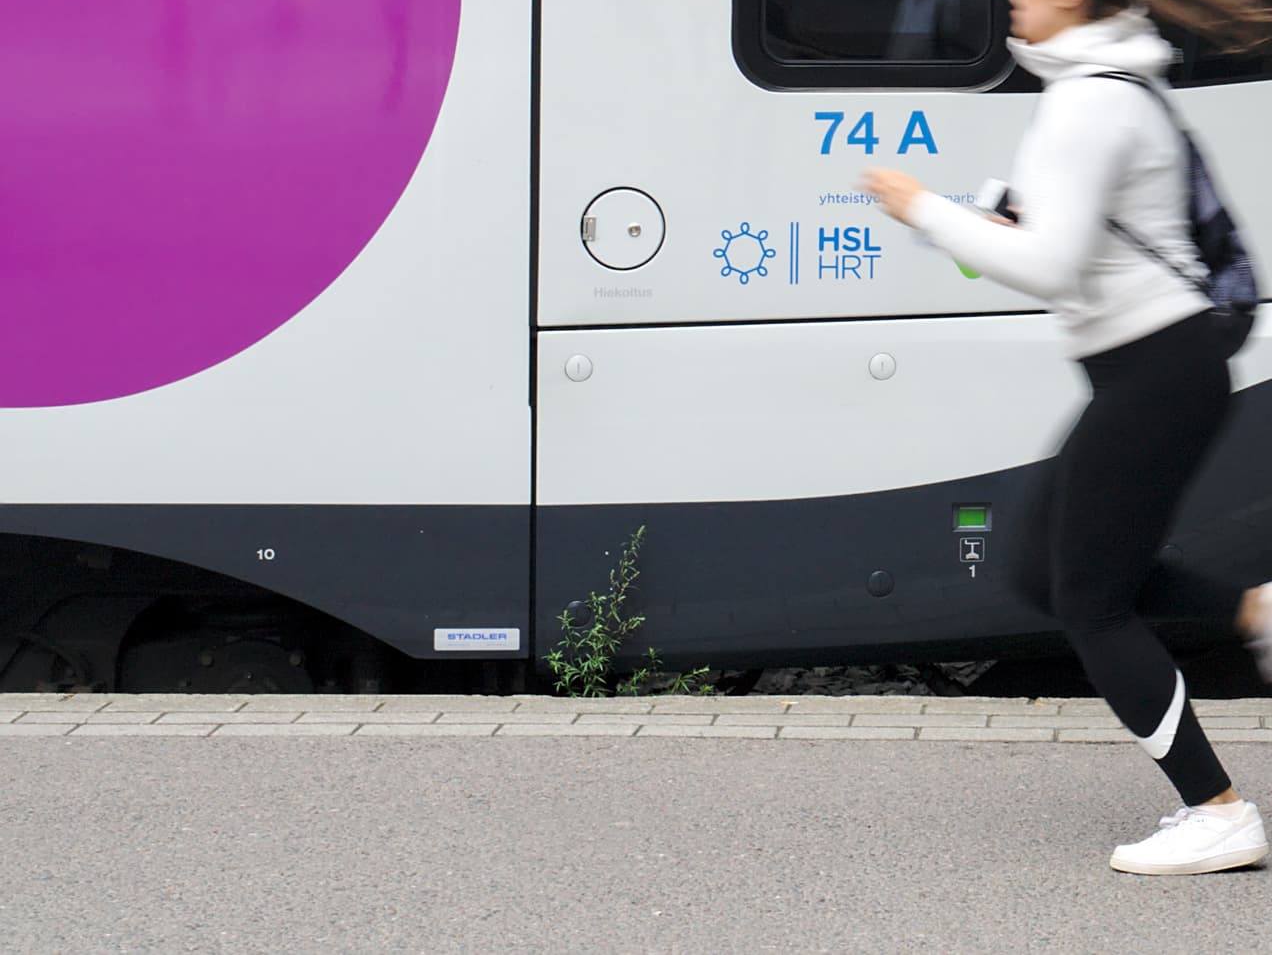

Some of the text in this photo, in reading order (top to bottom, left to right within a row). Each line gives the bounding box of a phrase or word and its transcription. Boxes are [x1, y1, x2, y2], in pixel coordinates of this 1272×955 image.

[815, 111, 939, 155] 74 A
[818, 227, 881, 252] HSL
[818, 254, 882, 280] HRT
[256, 548, 275, 560] 10
[969, 564, 976, 578] 1
[447, 632, 507, 641] STADLER
